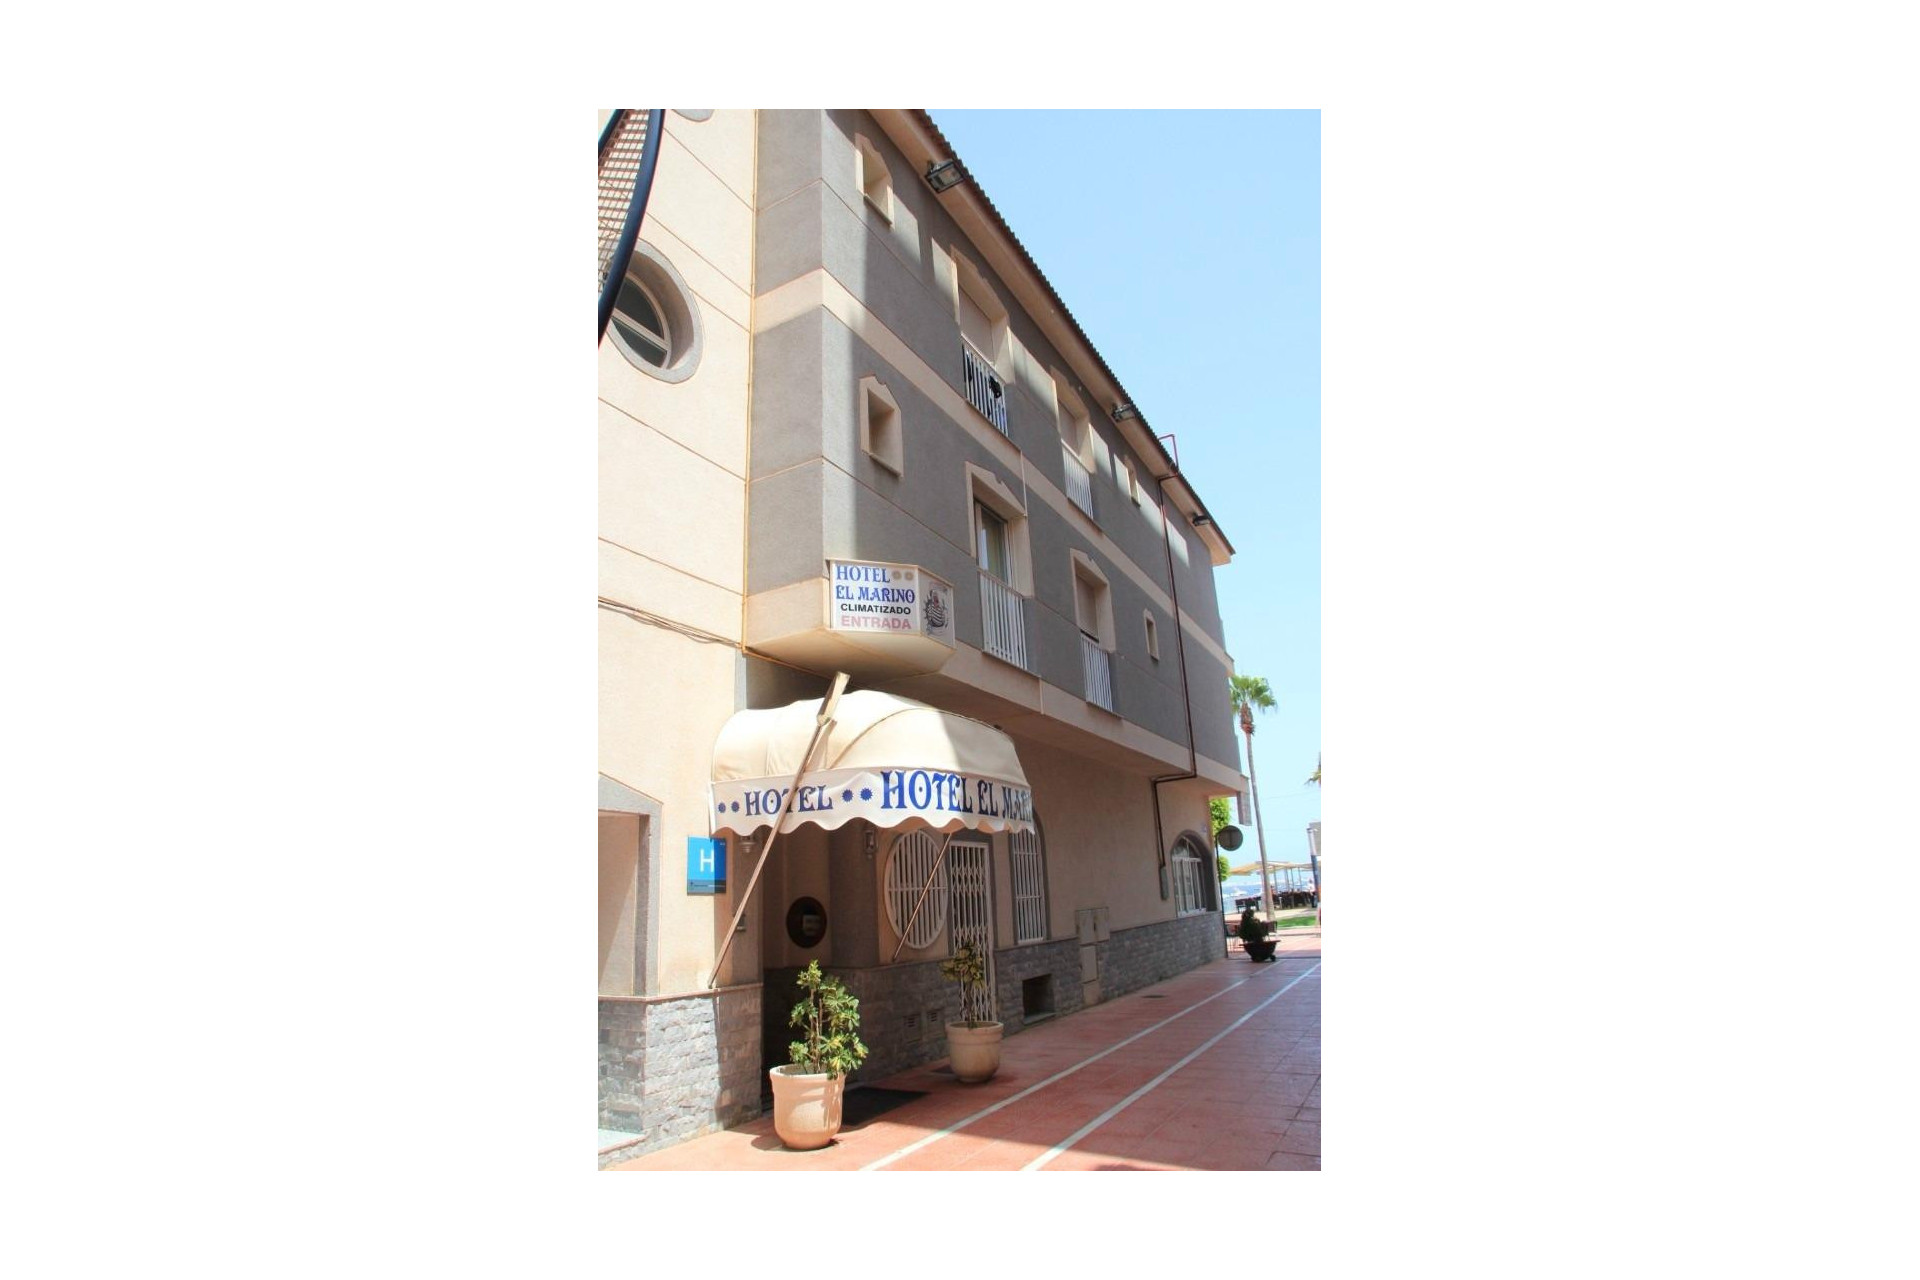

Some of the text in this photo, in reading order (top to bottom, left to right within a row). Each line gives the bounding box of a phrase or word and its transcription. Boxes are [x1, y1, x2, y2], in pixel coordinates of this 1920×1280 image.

[836, 565, 891, 582] HOTEL
[836, 584, 915, 604] EL MARINO
[840, 603, 911, 615] CLIMATIZADO
[841, 615, 911, 629] ENTRADA
[881, 770, 973, 813] HOTEL
[977, 780, 998, 816] EL
[700, 849, 715, 873] H
